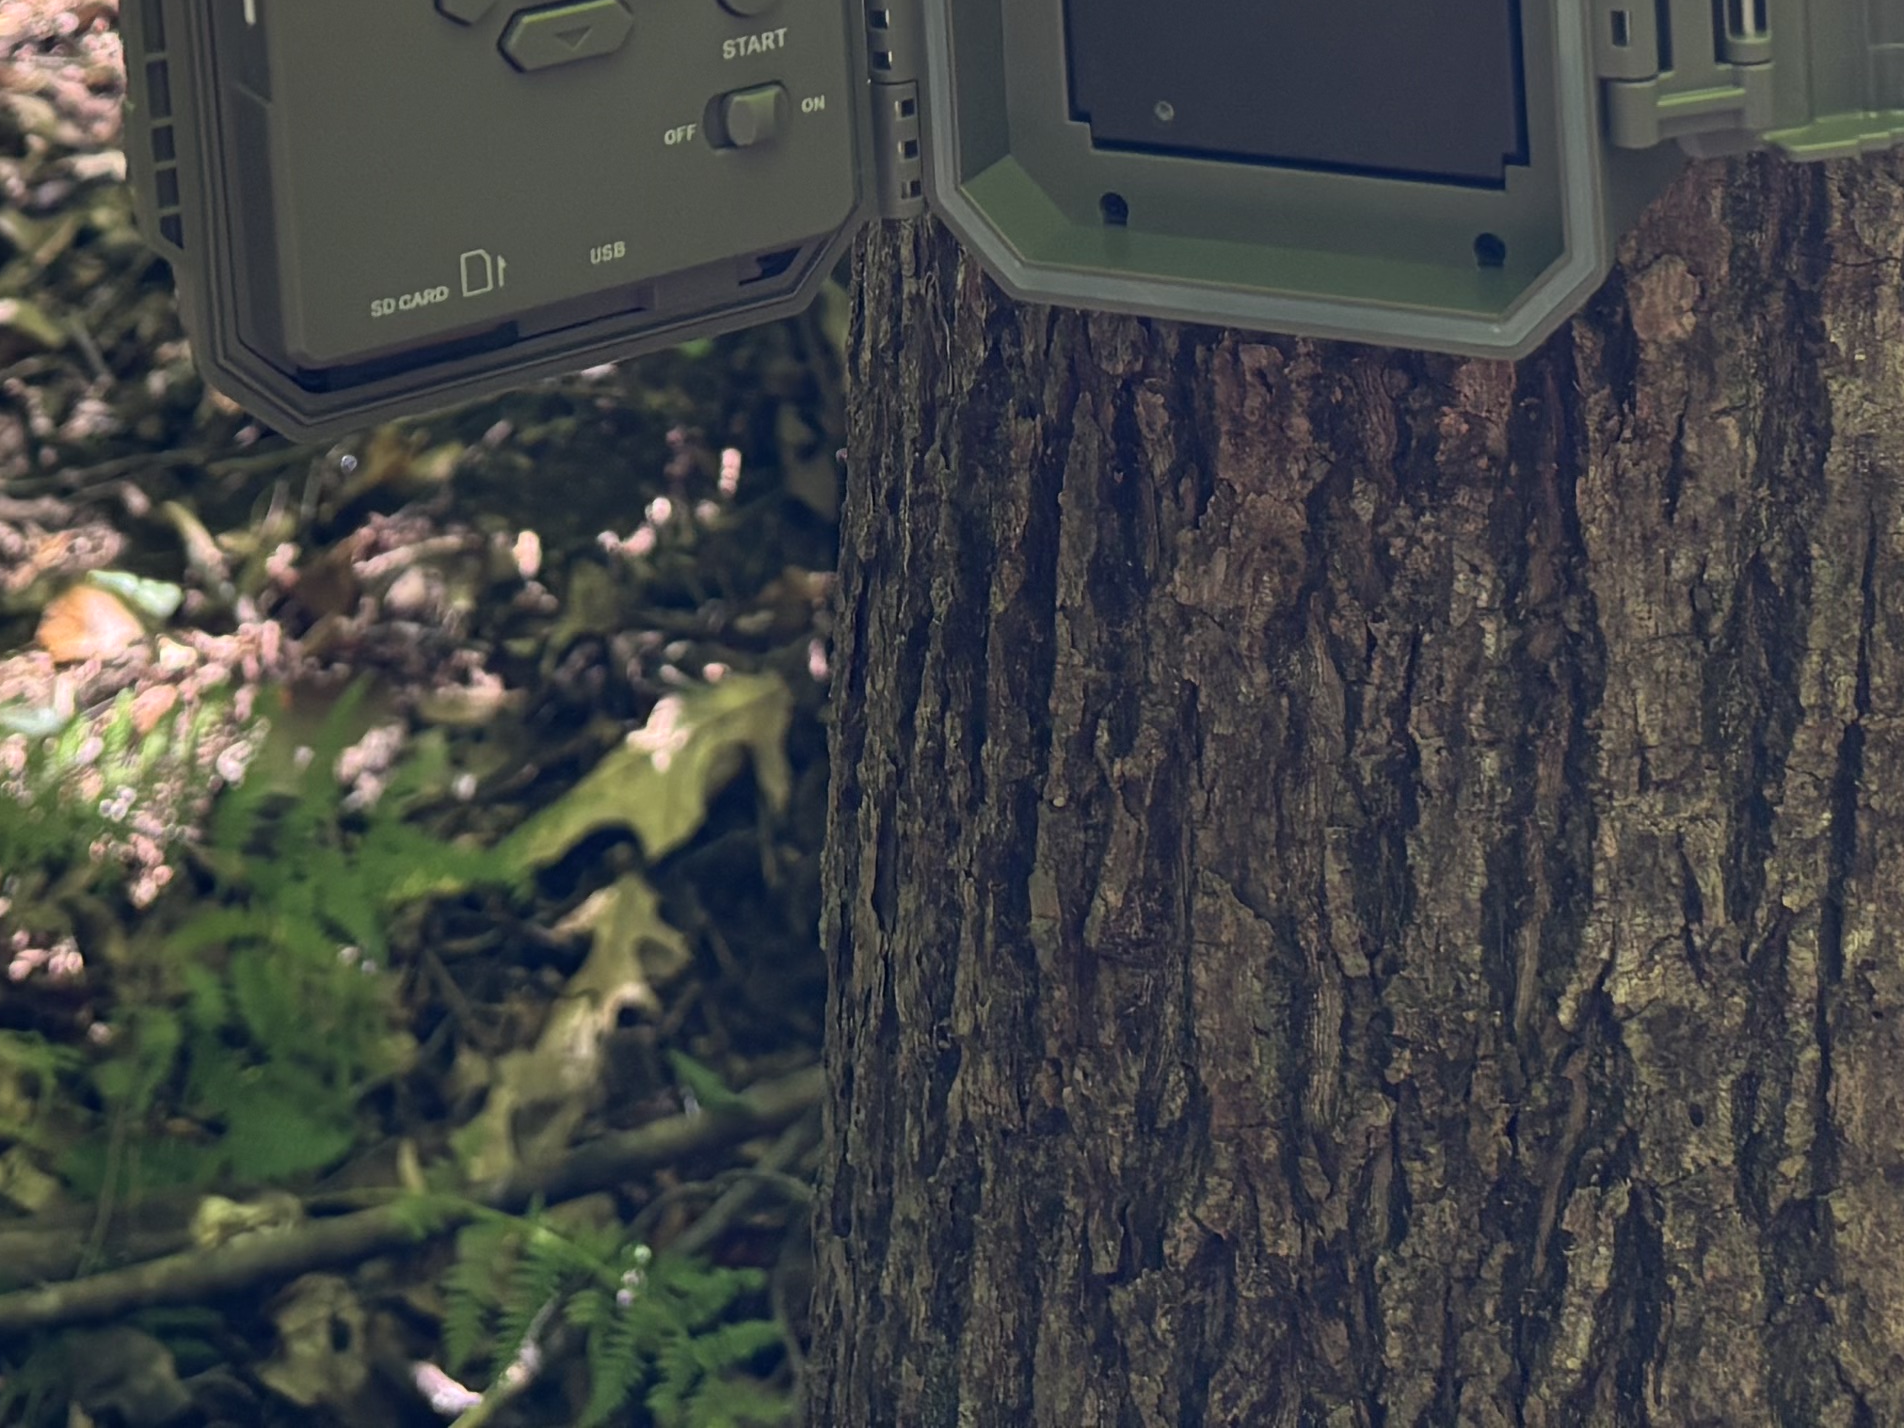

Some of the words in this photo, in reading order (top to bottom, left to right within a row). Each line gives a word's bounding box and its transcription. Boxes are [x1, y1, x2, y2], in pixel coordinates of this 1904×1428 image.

[721, 28, 788, 59] START
[801, 94, 826, 113] ON
[663, 123, 696, 146] OFF
[589, 241, 627, 266] USB
[370, 295, 395, 318] SD
[398, 284, 449, 312] CARD
